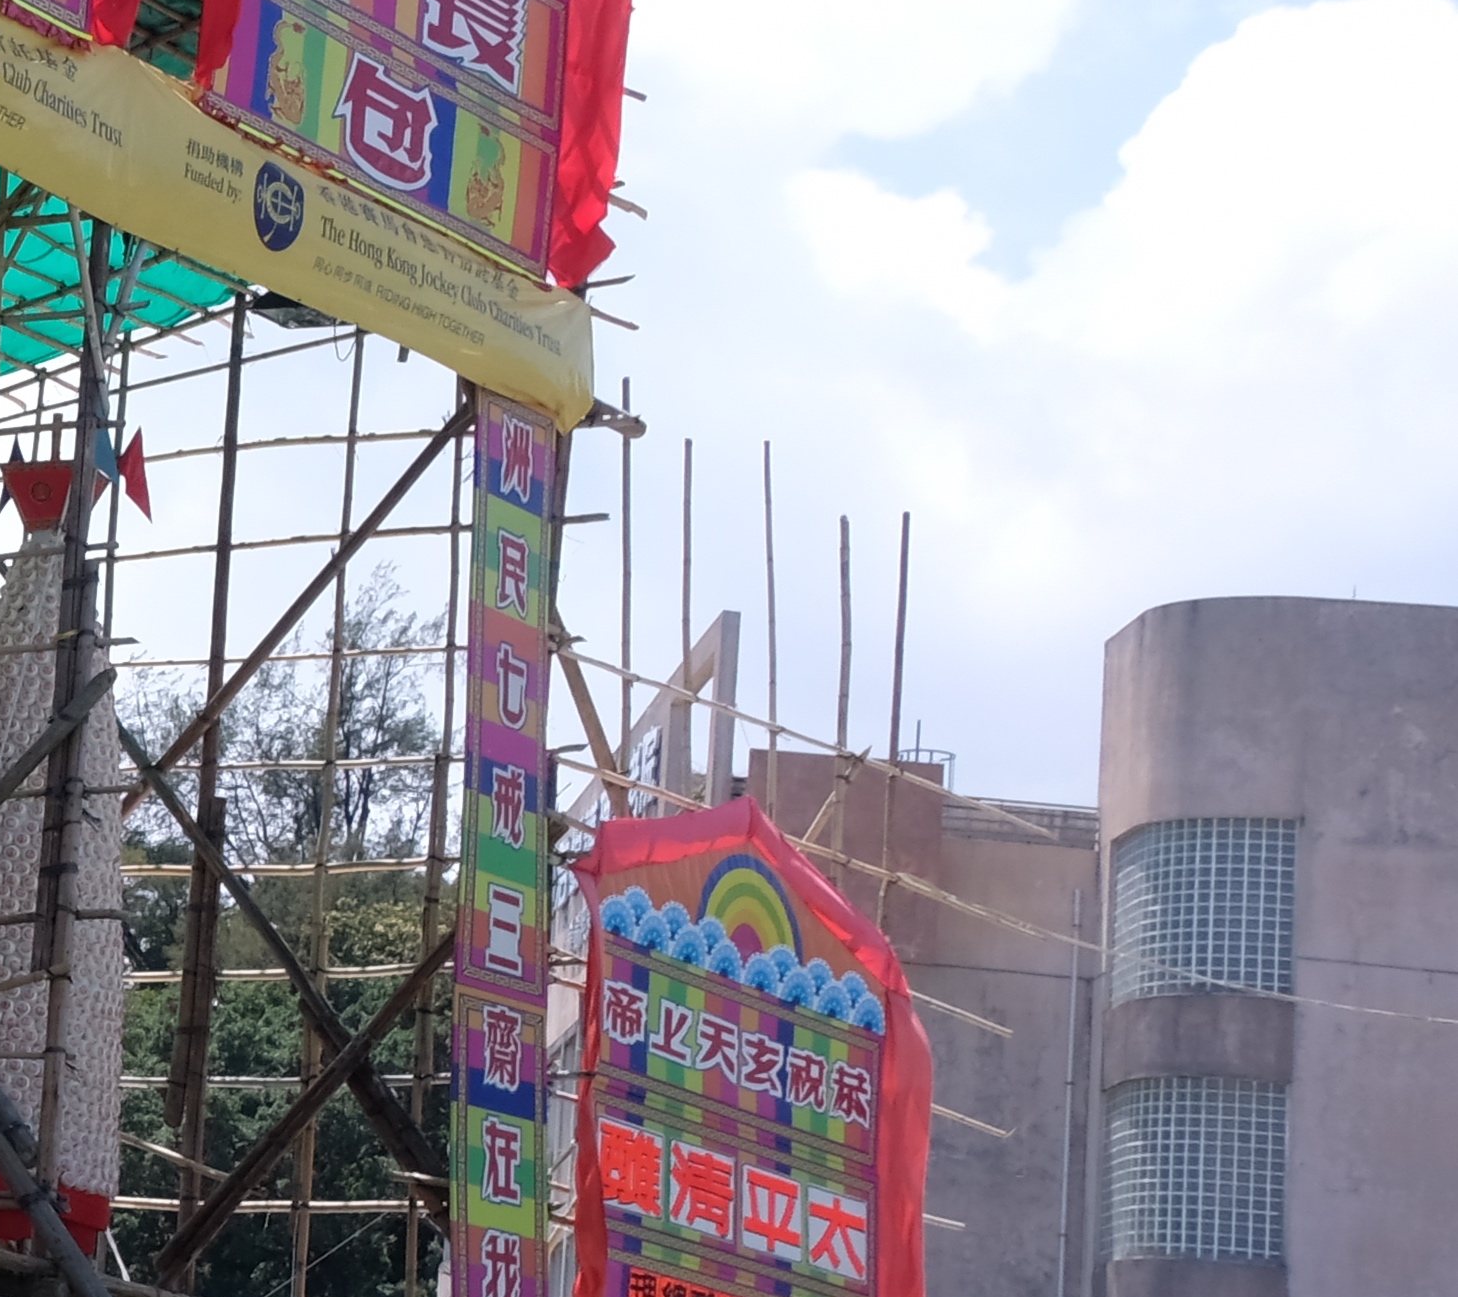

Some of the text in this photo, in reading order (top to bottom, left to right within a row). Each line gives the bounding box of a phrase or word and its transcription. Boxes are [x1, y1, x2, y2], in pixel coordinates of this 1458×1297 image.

[2, 60, 33, 96] Club
[33, 77, 88, 128] Charities
[89, 108, 124, 149] Trust
[334, 50, 439, 194] 包
[183, 161, 226, 195] Funded
[320, 214, 348, 244] The
[347, 228, 385, 271] Hong
[385, 249, 419, 284] Kong
[420, 264, 460, 306] Jockey
[459, 283, 487, 316] Club
[535, 324, 563, 357] Trust
[375, 282, 487, 348] RIDING HIGH TOGETHER
